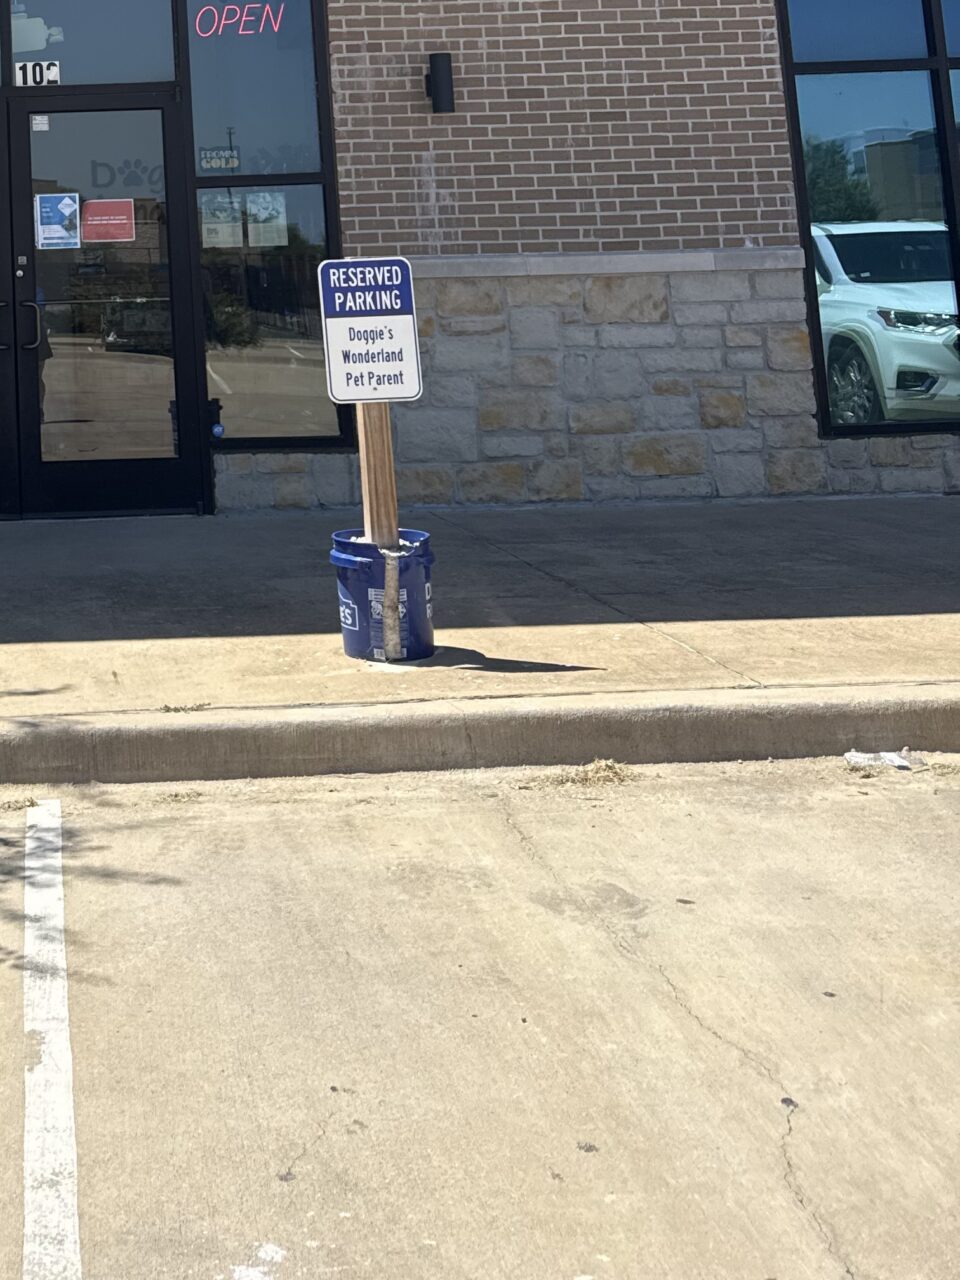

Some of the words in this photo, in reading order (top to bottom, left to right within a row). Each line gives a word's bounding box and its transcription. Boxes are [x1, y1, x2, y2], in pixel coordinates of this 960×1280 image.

[195, 2, 285, 37] OPEN
[200, 157, 240, 169] GOLD
[329, 265, 402, 288] RESERVED
[334, 289, 401, 312] PARKING
[348, 325, 394, 345] Doggie's
[342, 347, 404, 364] Wonderland
[345, 372, 365, 387] Pet
[367, 370, 404, 386] Parent
